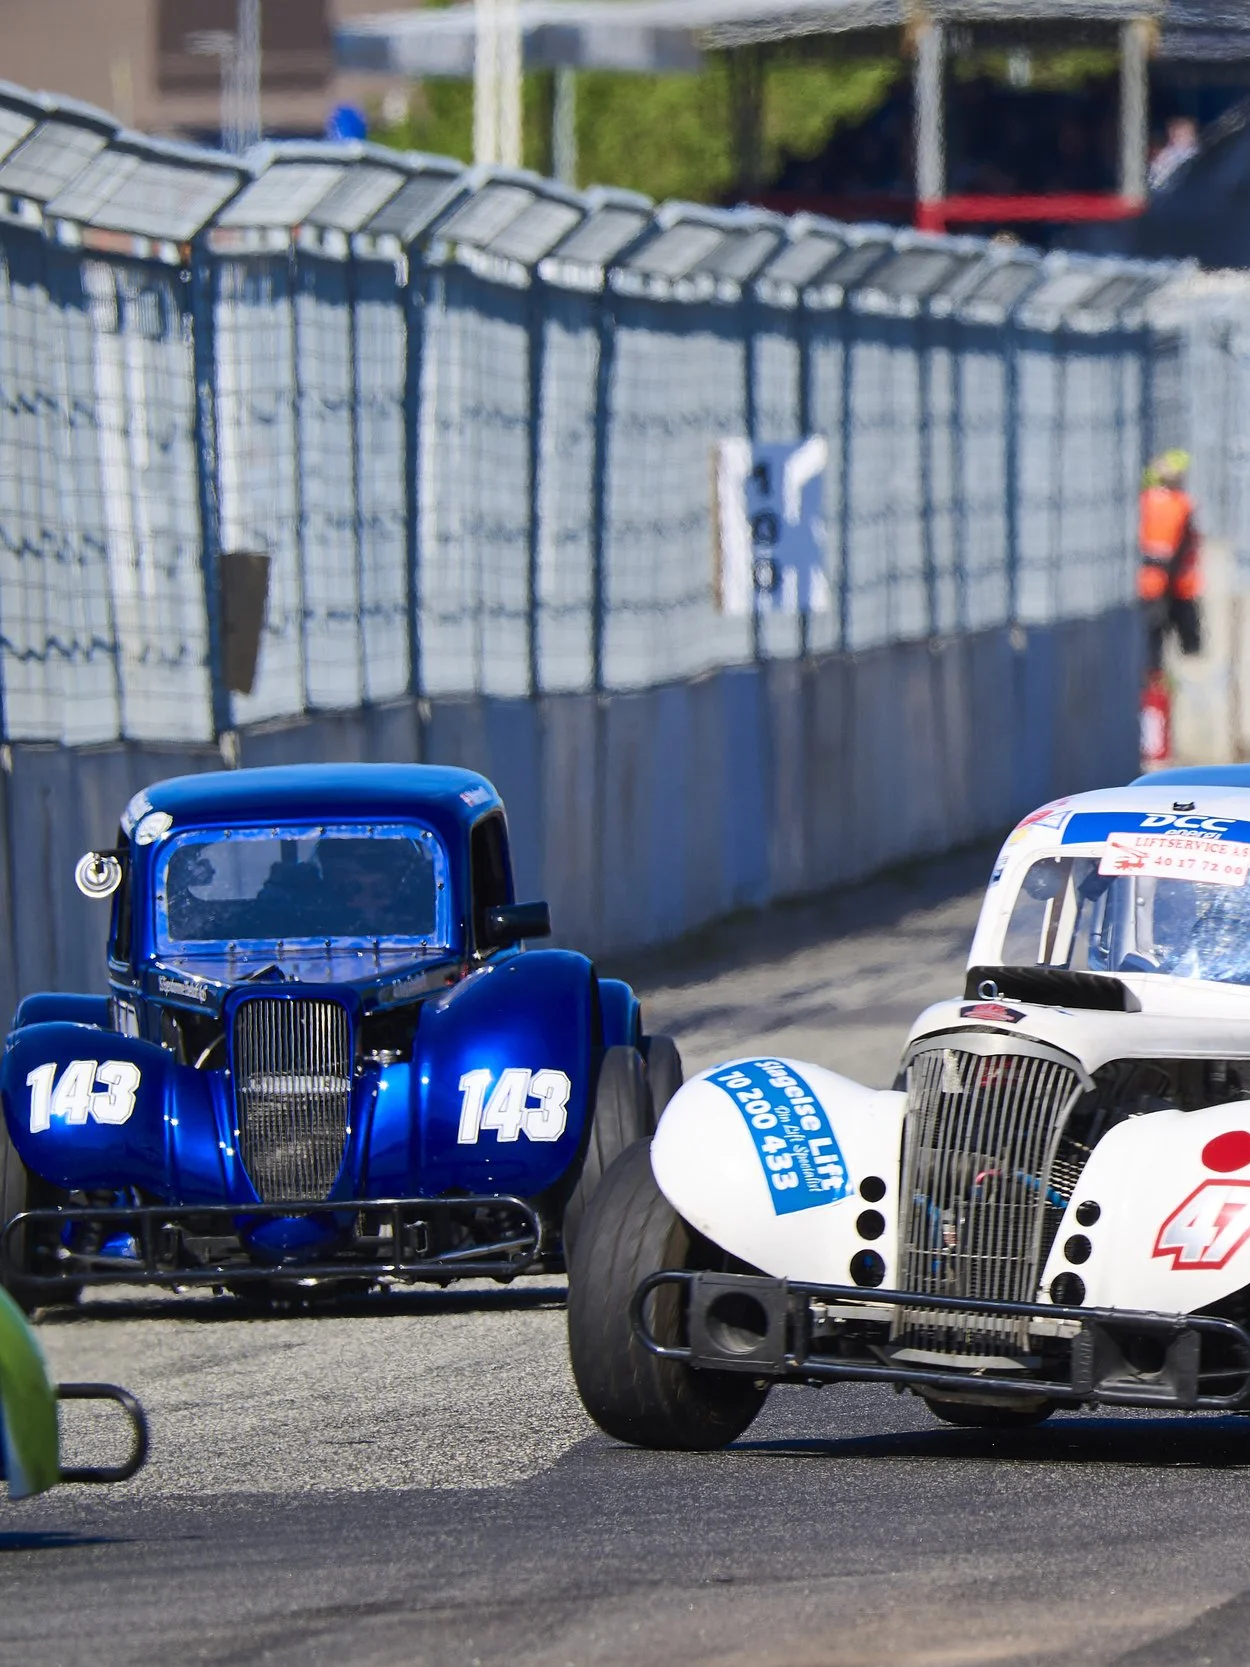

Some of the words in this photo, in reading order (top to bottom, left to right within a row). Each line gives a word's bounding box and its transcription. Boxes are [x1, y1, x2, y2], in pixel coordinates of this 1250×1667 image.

[1135, 837, 1228, 854] LIFTSERVICE
[1140, 813, 1236, 832] DCC
[1154, 856, 1173, 866] 40
[1178, 858, 1196, 869] 17
[1201, 861, 1218, 871] 72
[1224, 865, 1243, 875] 00
[26, 1060, 141, 1134] 143
[457, 1068, 571, 1144] 143
[754, 1061, 821, 1131] Slagelse
[807, 1137, 845, 1191] Lift
[736, 1088, 778, 1130] 200
[761, 1135, 799, 1190] 433
